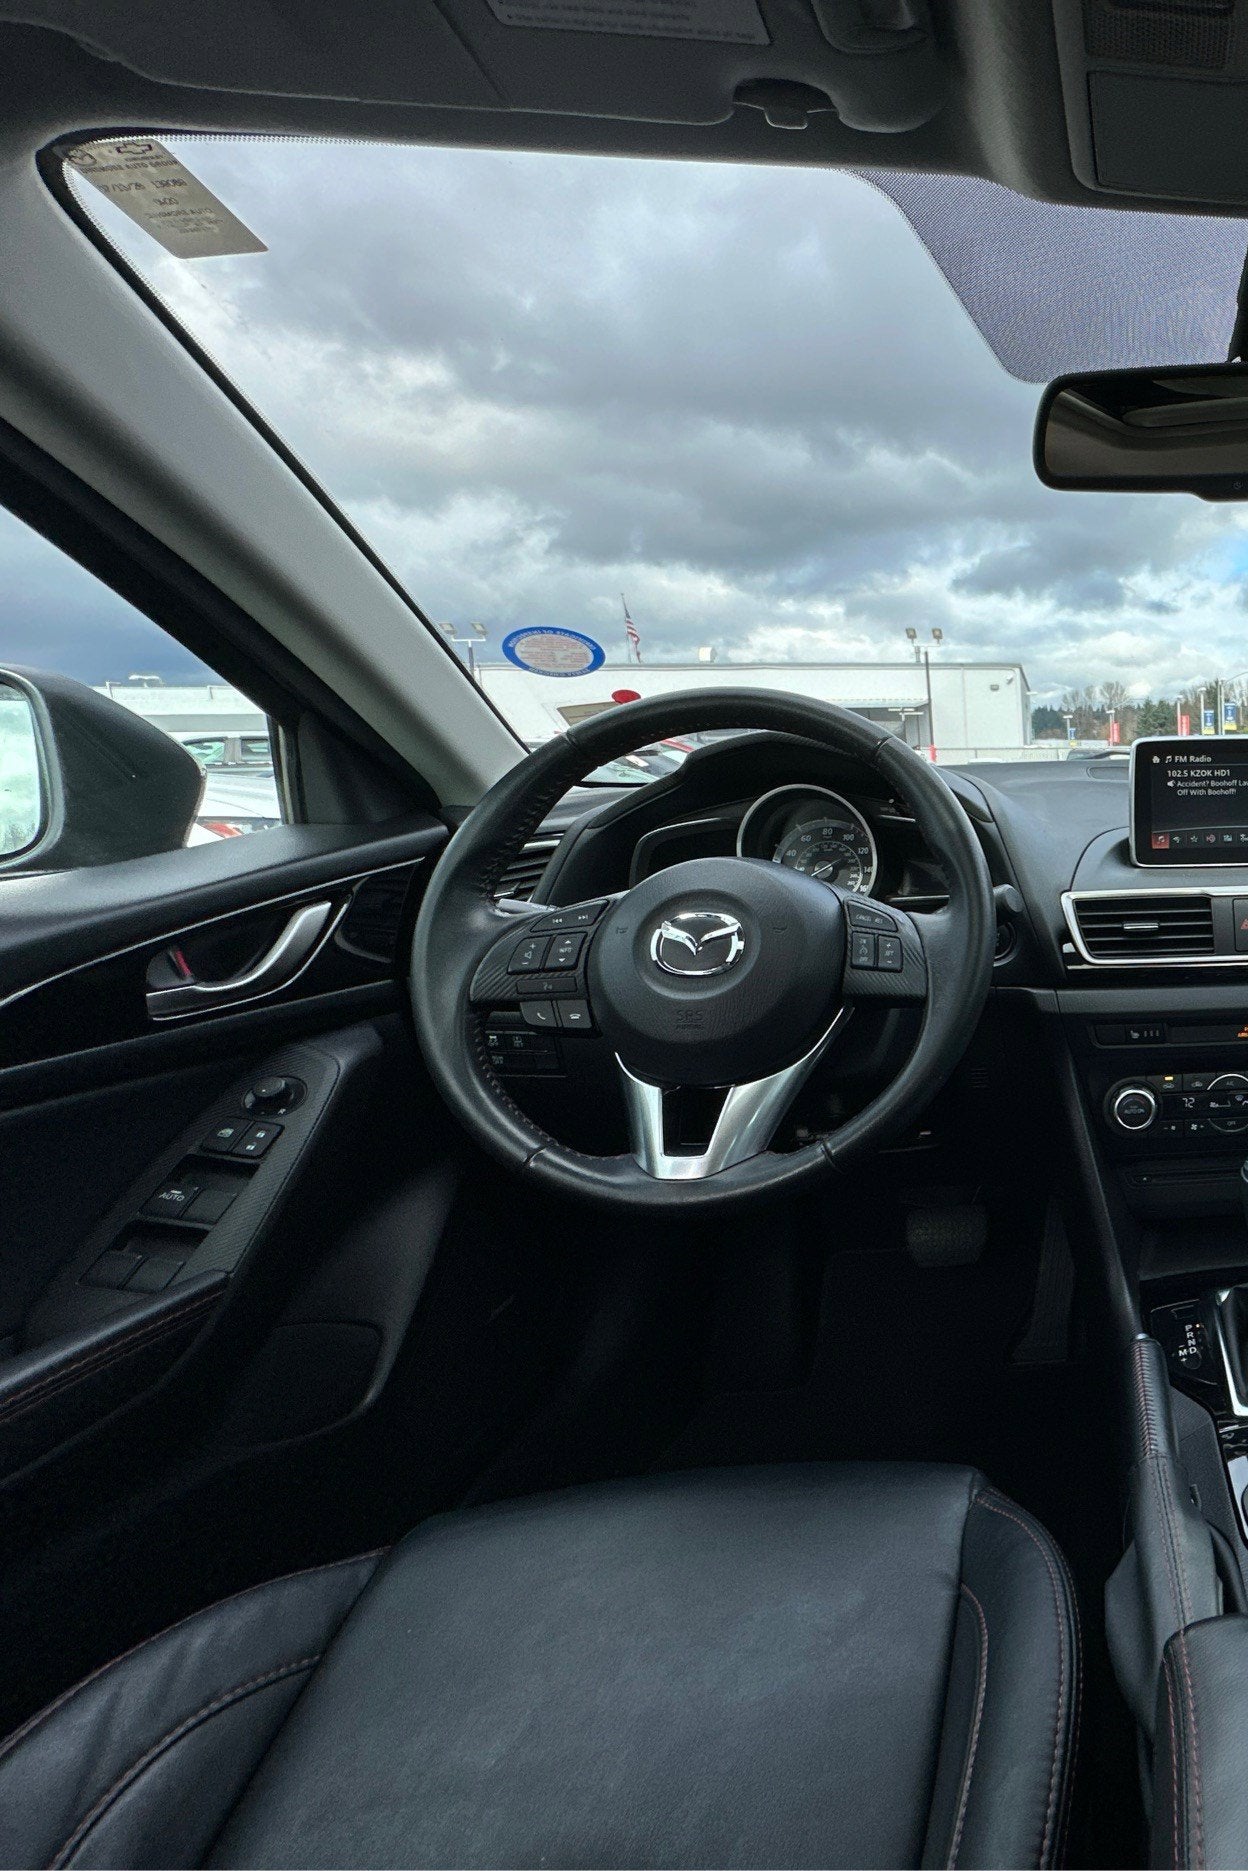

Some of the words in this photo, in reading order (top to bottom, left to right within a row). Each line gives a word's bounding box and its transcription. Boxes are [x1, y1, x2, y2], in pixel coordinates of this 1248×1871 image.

[1174, 755, 1188, 763] FM
[1189, 754, 1212, 763] Radio
[1167, 769, 1189, 778] 102.5
[1190, 769, 1213, 777] KZOK
[1214, 768, 1231, 777] HD1
[786, 849, 797, 857] 40
[857, 847, 869, 855] 120
[1182, 1097, 1195, 1108] 72
[158, 1191, 186, 1202] AUTO
[1186, 1331, 1195, 1339] R
[1187, 1339, 1197, 1347] N
[1178, 1348, 1188, 1357] M
[1189, 1346, 1198, 1354] D
